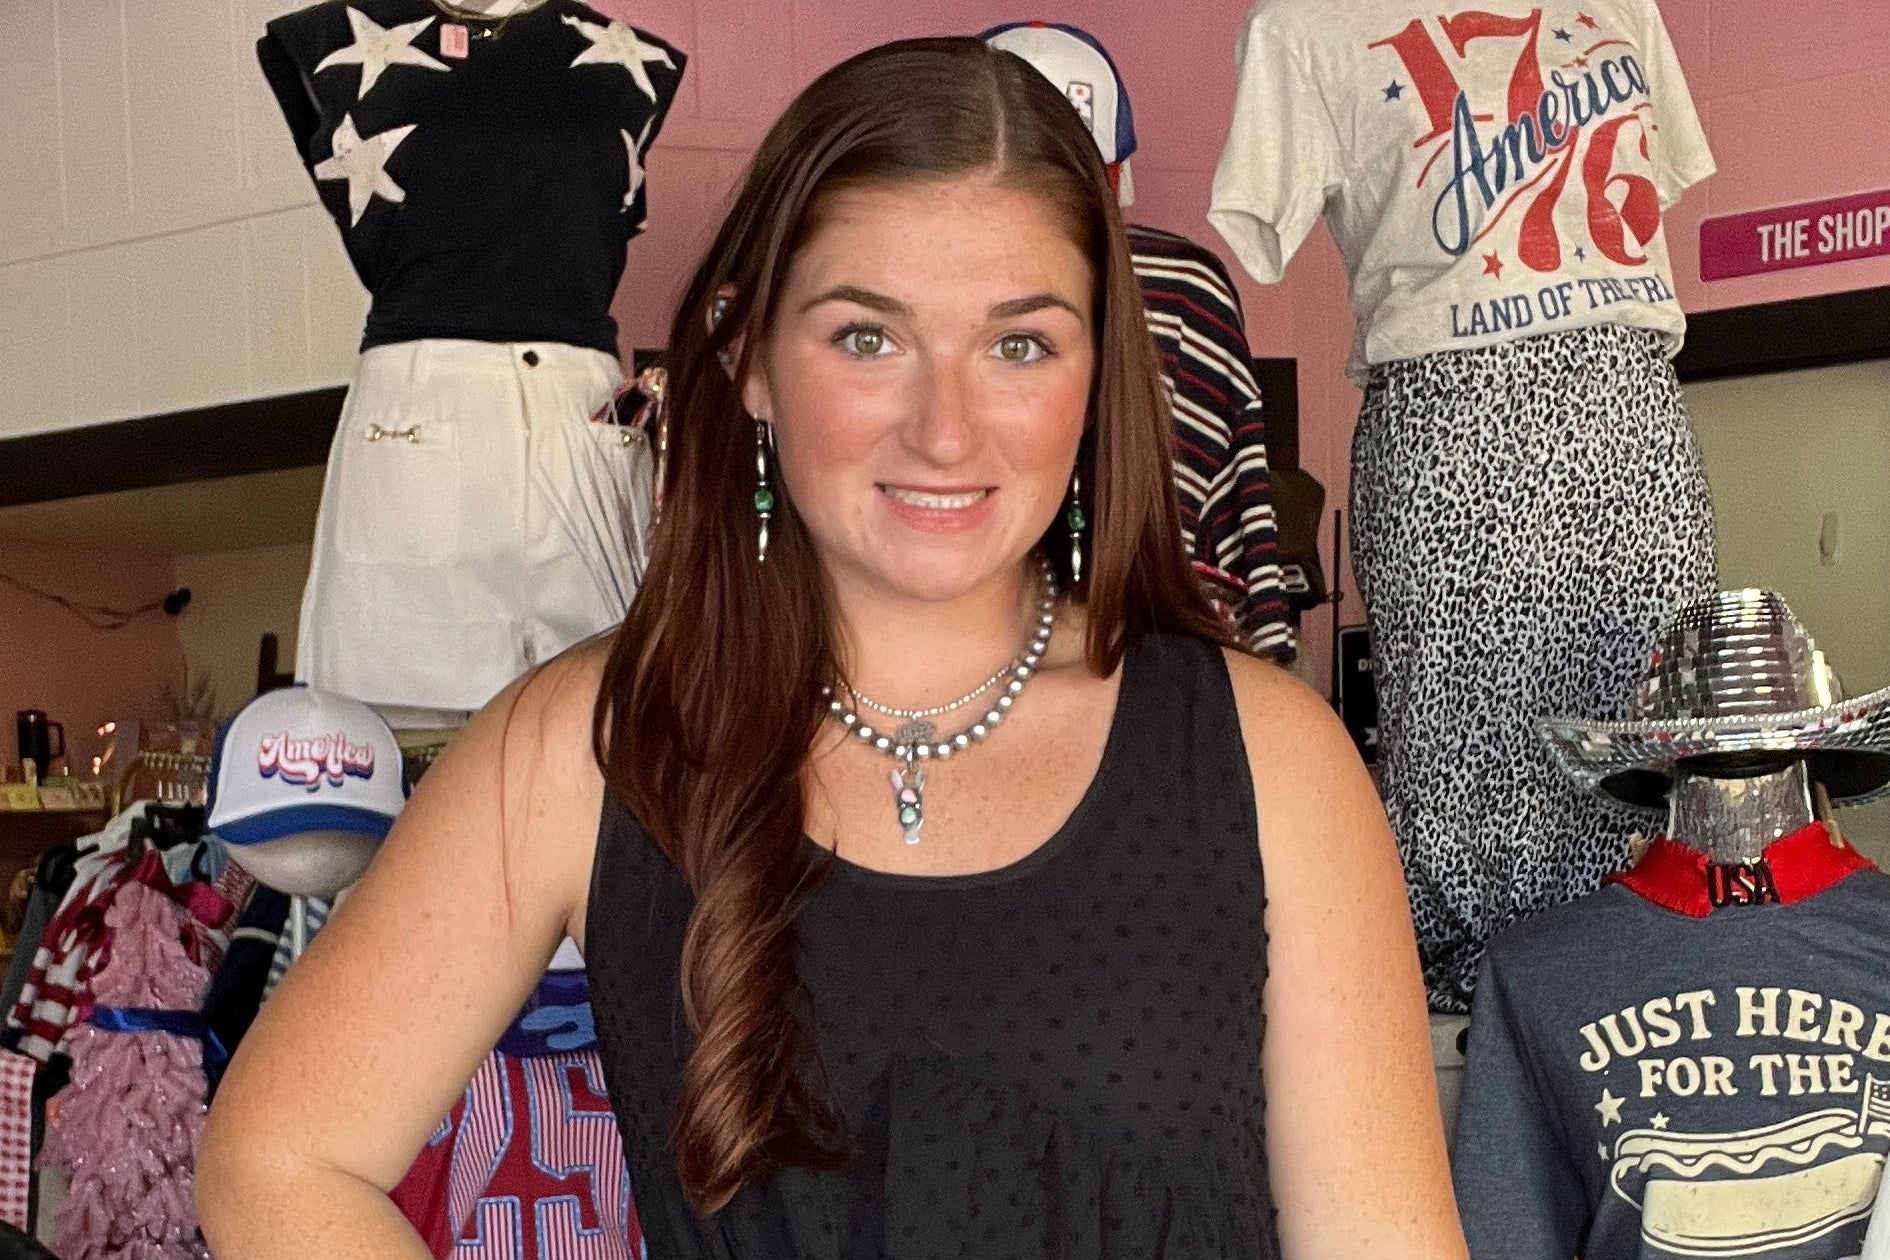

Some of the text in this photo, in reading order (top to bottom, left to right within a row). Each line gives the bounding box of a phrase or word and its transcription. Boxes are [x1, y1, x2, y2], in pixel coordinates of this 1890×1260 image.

[1433, 54, 1652, 256] America
[1757, 206, 1890, 262] THE SHOP
[1450, 294, 1533, 338] LAND
[1537, 282, 1574, 320] OF
[258, 730, 376, 794] America
[1706, 861, 1781, 908] USA
[1579, 989, 1716, 1073] JUST
[1637, 1053, 1860, 1098] FOR THE
